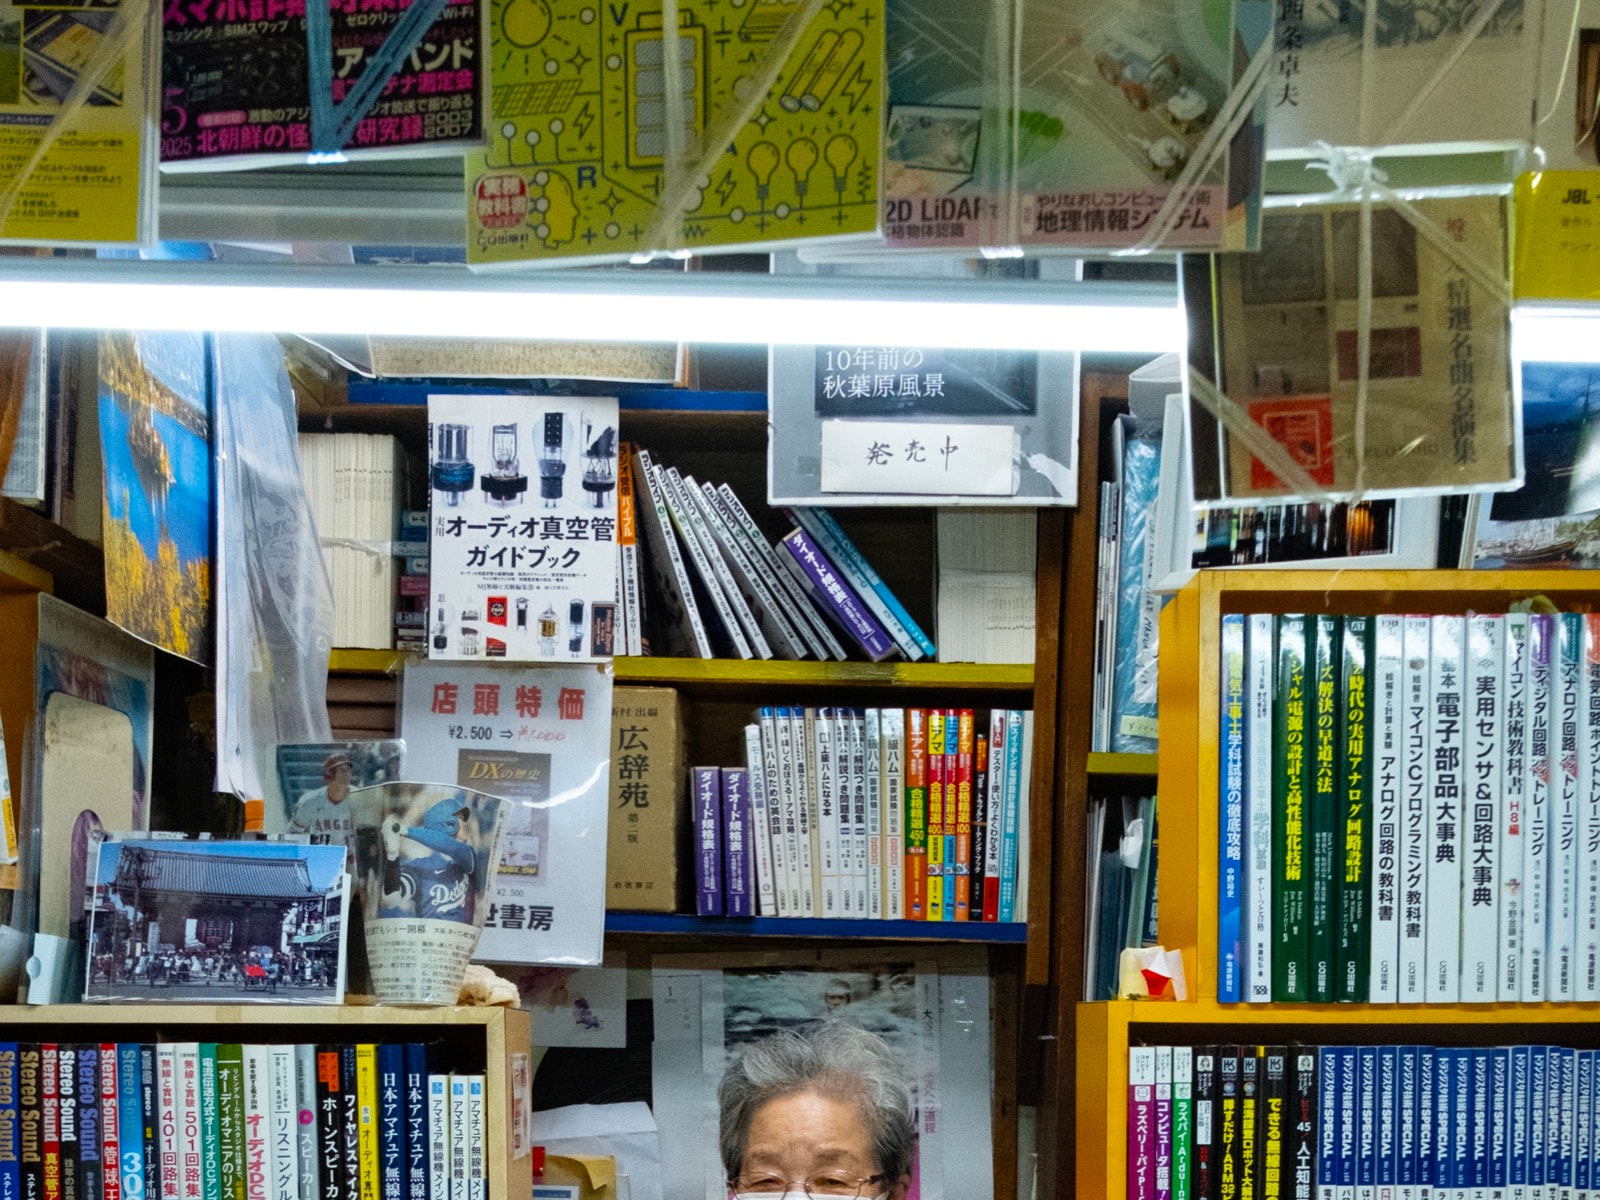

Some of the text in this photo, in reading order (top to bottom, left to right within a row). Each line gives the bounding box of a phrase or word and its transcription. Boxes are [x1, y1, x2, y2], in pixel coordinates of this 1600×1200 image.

[822, 373, 946, 399] 秋葉原風景
[823, 349, 924, 373] 10年前の
[865, 434, 961, 474] 発売中
[446, 515, 615, 542] オーディオ真空管
[466, 546, 581, 569] ガイドブック
[431, 682, 587, 721] 店頭特価
[1506, 642, 1525, 836] マイコン技術教科書 H8編
[616, 724, 651, 810] 広辞苑
[765, 750, 783, 836] ハムのための英会話
[1472, 675, 1497, 908] 実用センサ&回路大事典
[627, 812, 640, 845] 第二版
[700, 771, 716, 851] ダイオード規格表
[727, 772, 744, 851] ダイオード規格表
[1377, 756, 1396, 922] アナログ回路の教科書
[1405, 705, 1425, 939] マイコンCプログラミング教科書
[20, 1051, 41, 1163] Stereo Sound
[59, 1051, 77, 1142] Stereo Sound
[78, 1050, 99, 1161] Stereo Sound
[101, 1050, 118, 1142] Stereo Sound
[1296, 1121, 1312, 1132] 45
[162, 1110, 179, 1198] 401回路集
[184, 1110, 202, 1198] 501回路集
